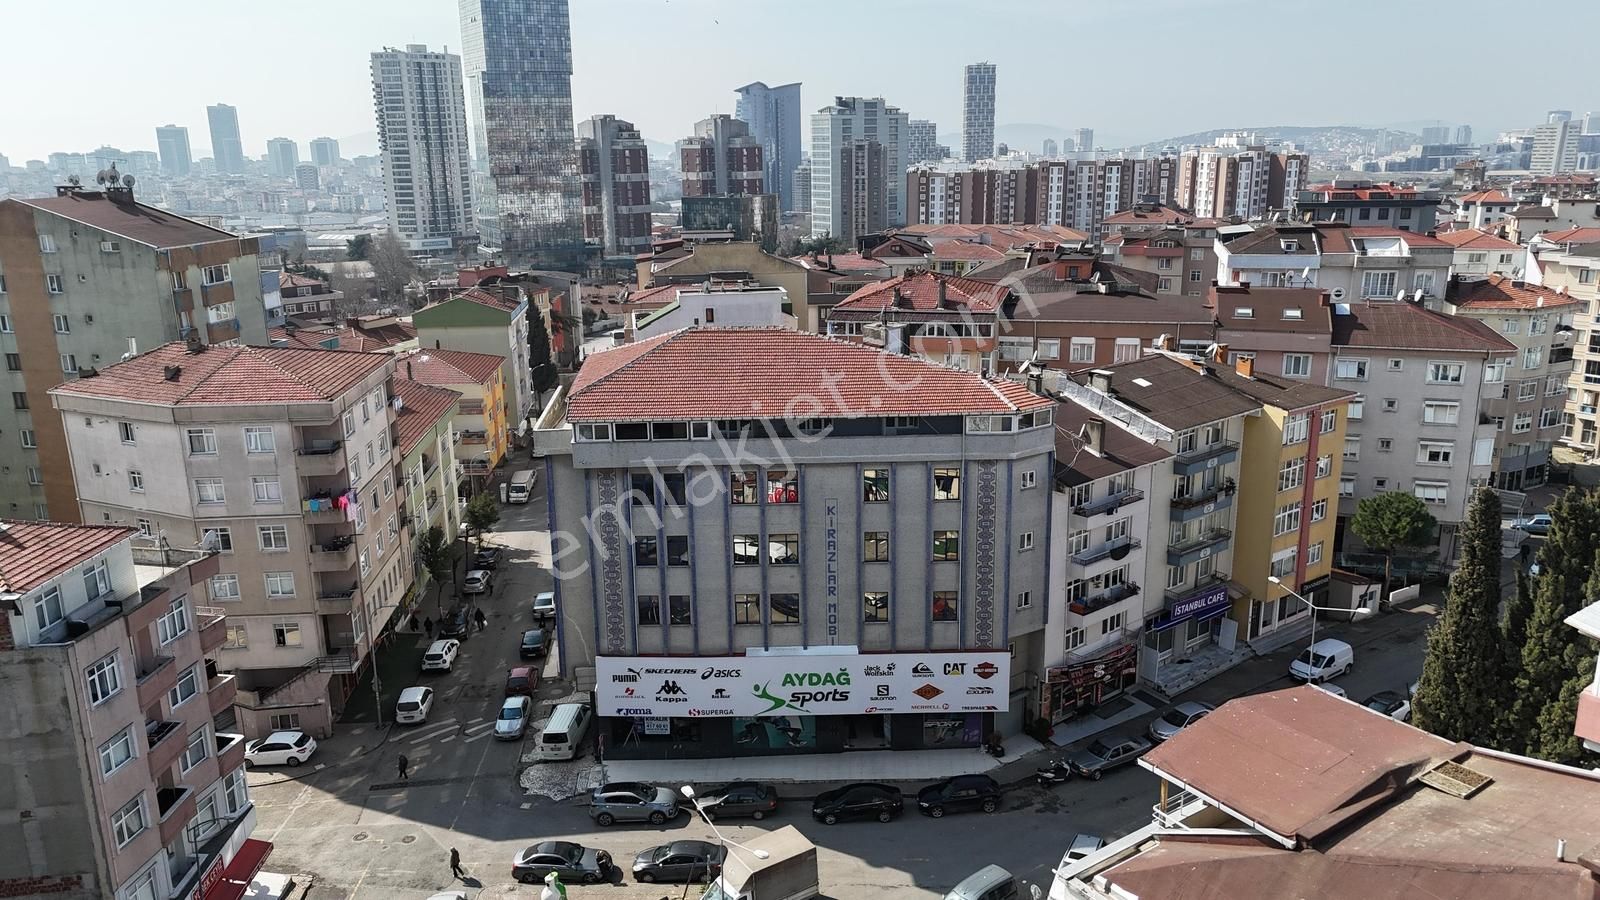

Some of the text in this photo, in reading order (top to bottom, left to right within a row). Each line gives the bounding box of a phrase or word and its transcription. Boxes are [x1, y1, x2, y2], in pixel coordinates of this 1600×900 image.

[375, 83, 384, 105] KULE
[1174, 591, 1225, 617] İSTANBUL CAFE
[781, 668, 851, 687] AYDAĞ
[864, 669, 894, 677] Wolfskin
[943, 662, 967, 675] CAT
[612, 674, 638, 682] PUMA
[789, 689, 850, 707] sports
